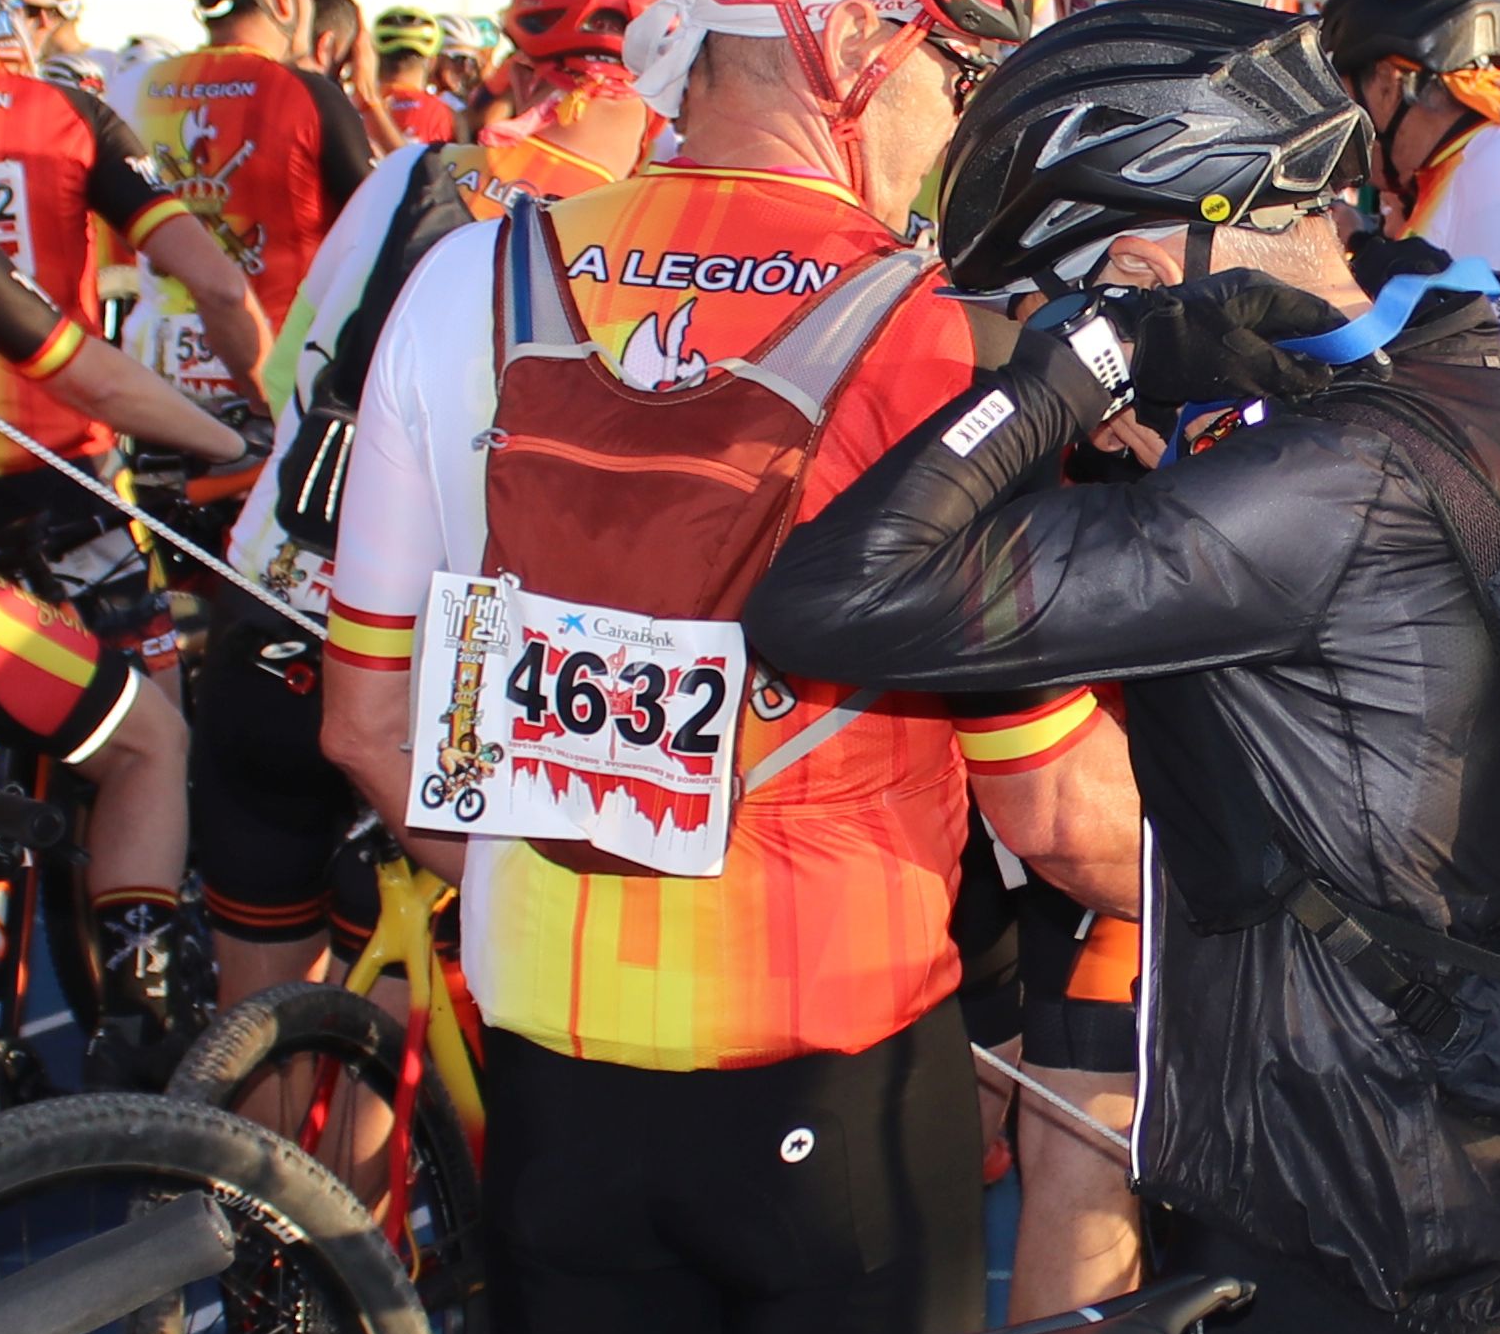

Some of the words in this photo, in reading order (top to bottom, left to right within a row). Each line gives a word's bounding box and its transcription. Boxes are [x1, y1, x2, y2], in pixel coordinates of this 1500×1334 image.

[567, 244, 611, 281] A
[621, 250, 840, 295] LEGIÓN
[457, 652, 486, 664] 2024
[505, 641, 727, 755] 4632
[211, 1177, 266, 1223] SWISS
[263, 1213, 309, 1245] DT
